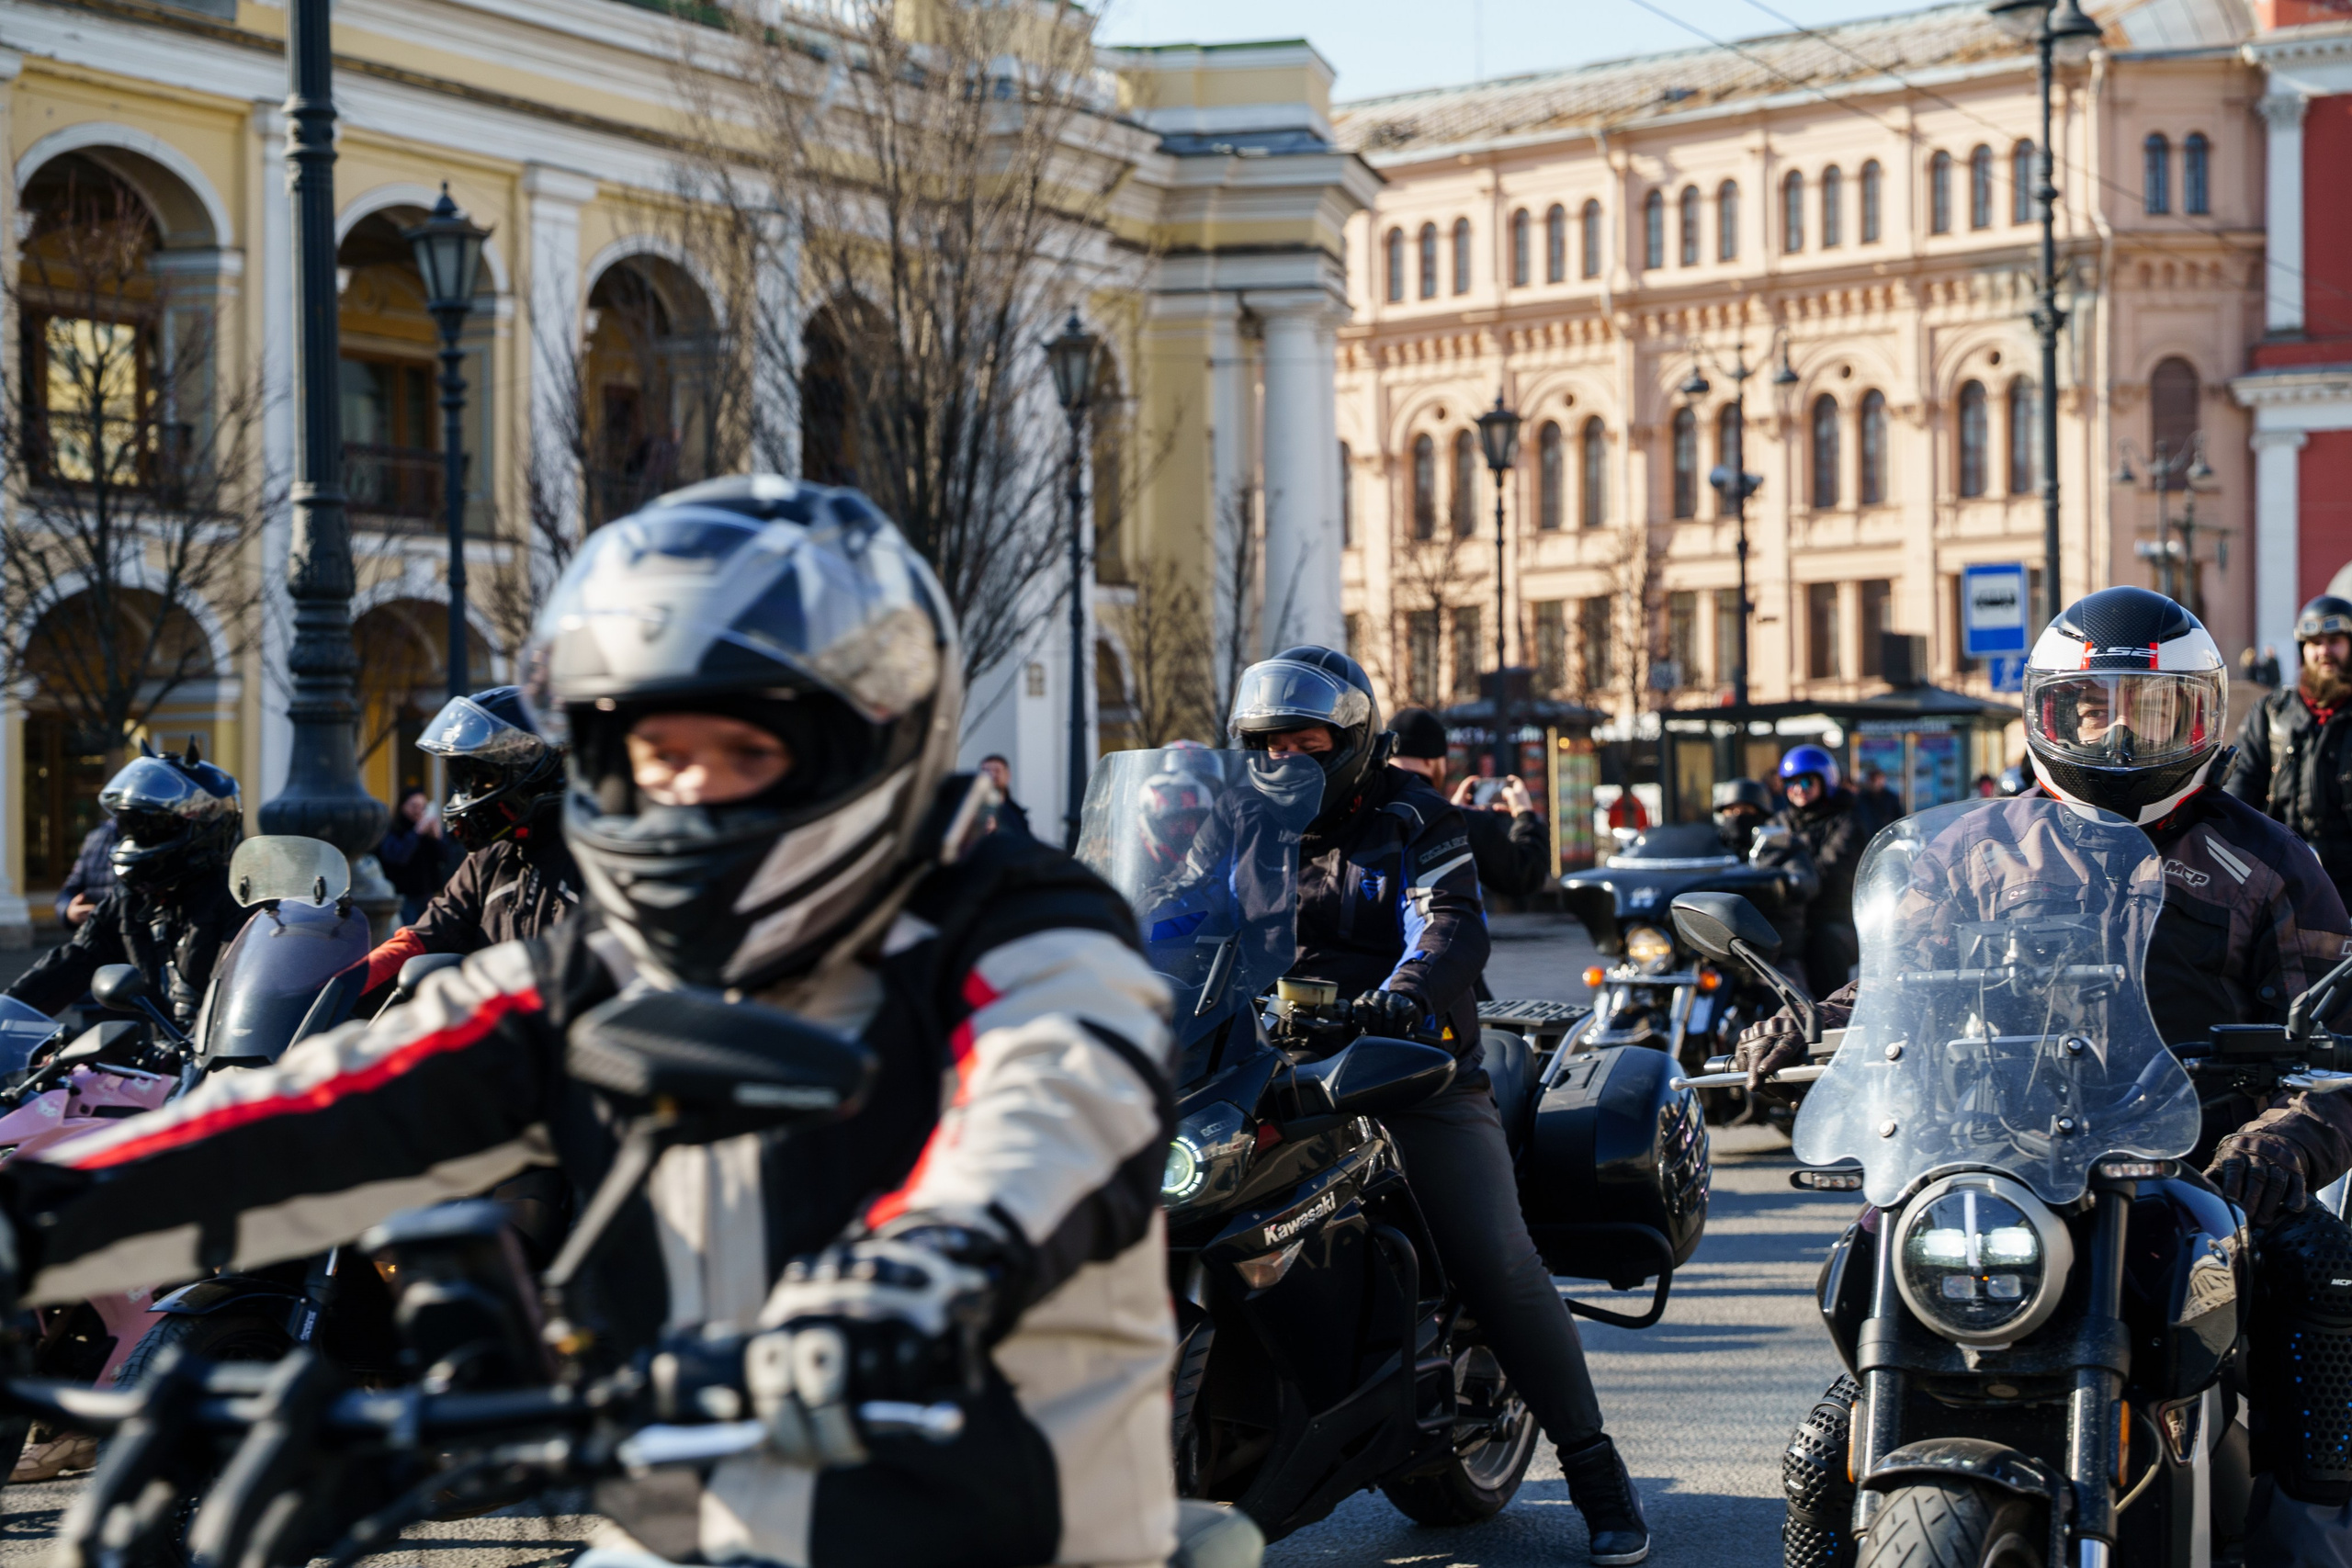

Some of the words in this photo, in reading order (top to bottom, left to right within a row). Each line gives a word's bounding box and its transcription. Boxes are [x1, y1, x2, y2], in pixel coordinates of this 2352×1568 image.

[2084, 647, 2157, 659] LS2
[2163, 859, 2211, 887] MCP
[1263, 1191, 1336, 1247] Kawasaki
